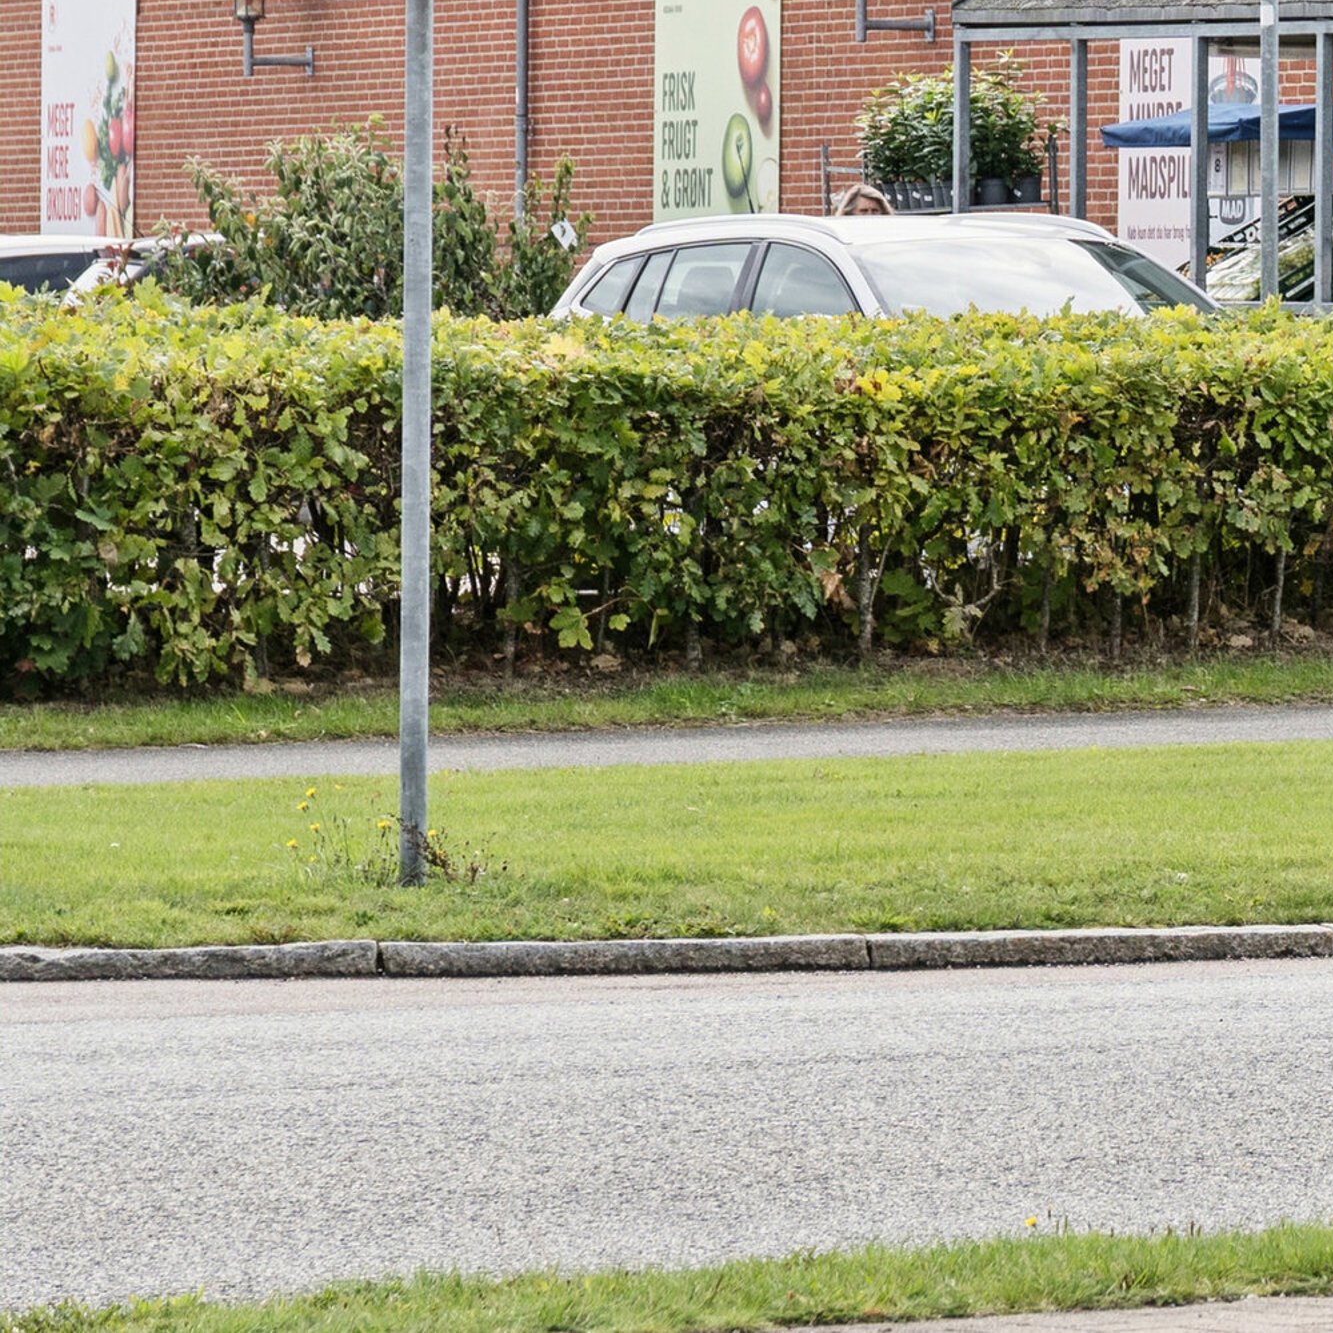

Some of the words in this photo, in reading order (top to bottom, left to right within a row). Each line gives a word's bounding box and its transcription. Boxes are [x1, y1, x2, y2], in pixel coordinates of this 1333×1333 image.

[1129, 48, 1174, 93] MEGET
[662, 71, 696, 112] FRISK
[47, 103, 75, 138] MEGET
[661, 119, 699, 160] FRUGT
[47, 145, 69, 179] MERE
[1128, 154, 1192, 200] MADSPIL
[46, 187, 81, 221] ØKOLOGI
[661, 169, 670, 209] &
[674, 168, 714, 208] GRØNT
[1221, 199, 1243, 219] MAD
